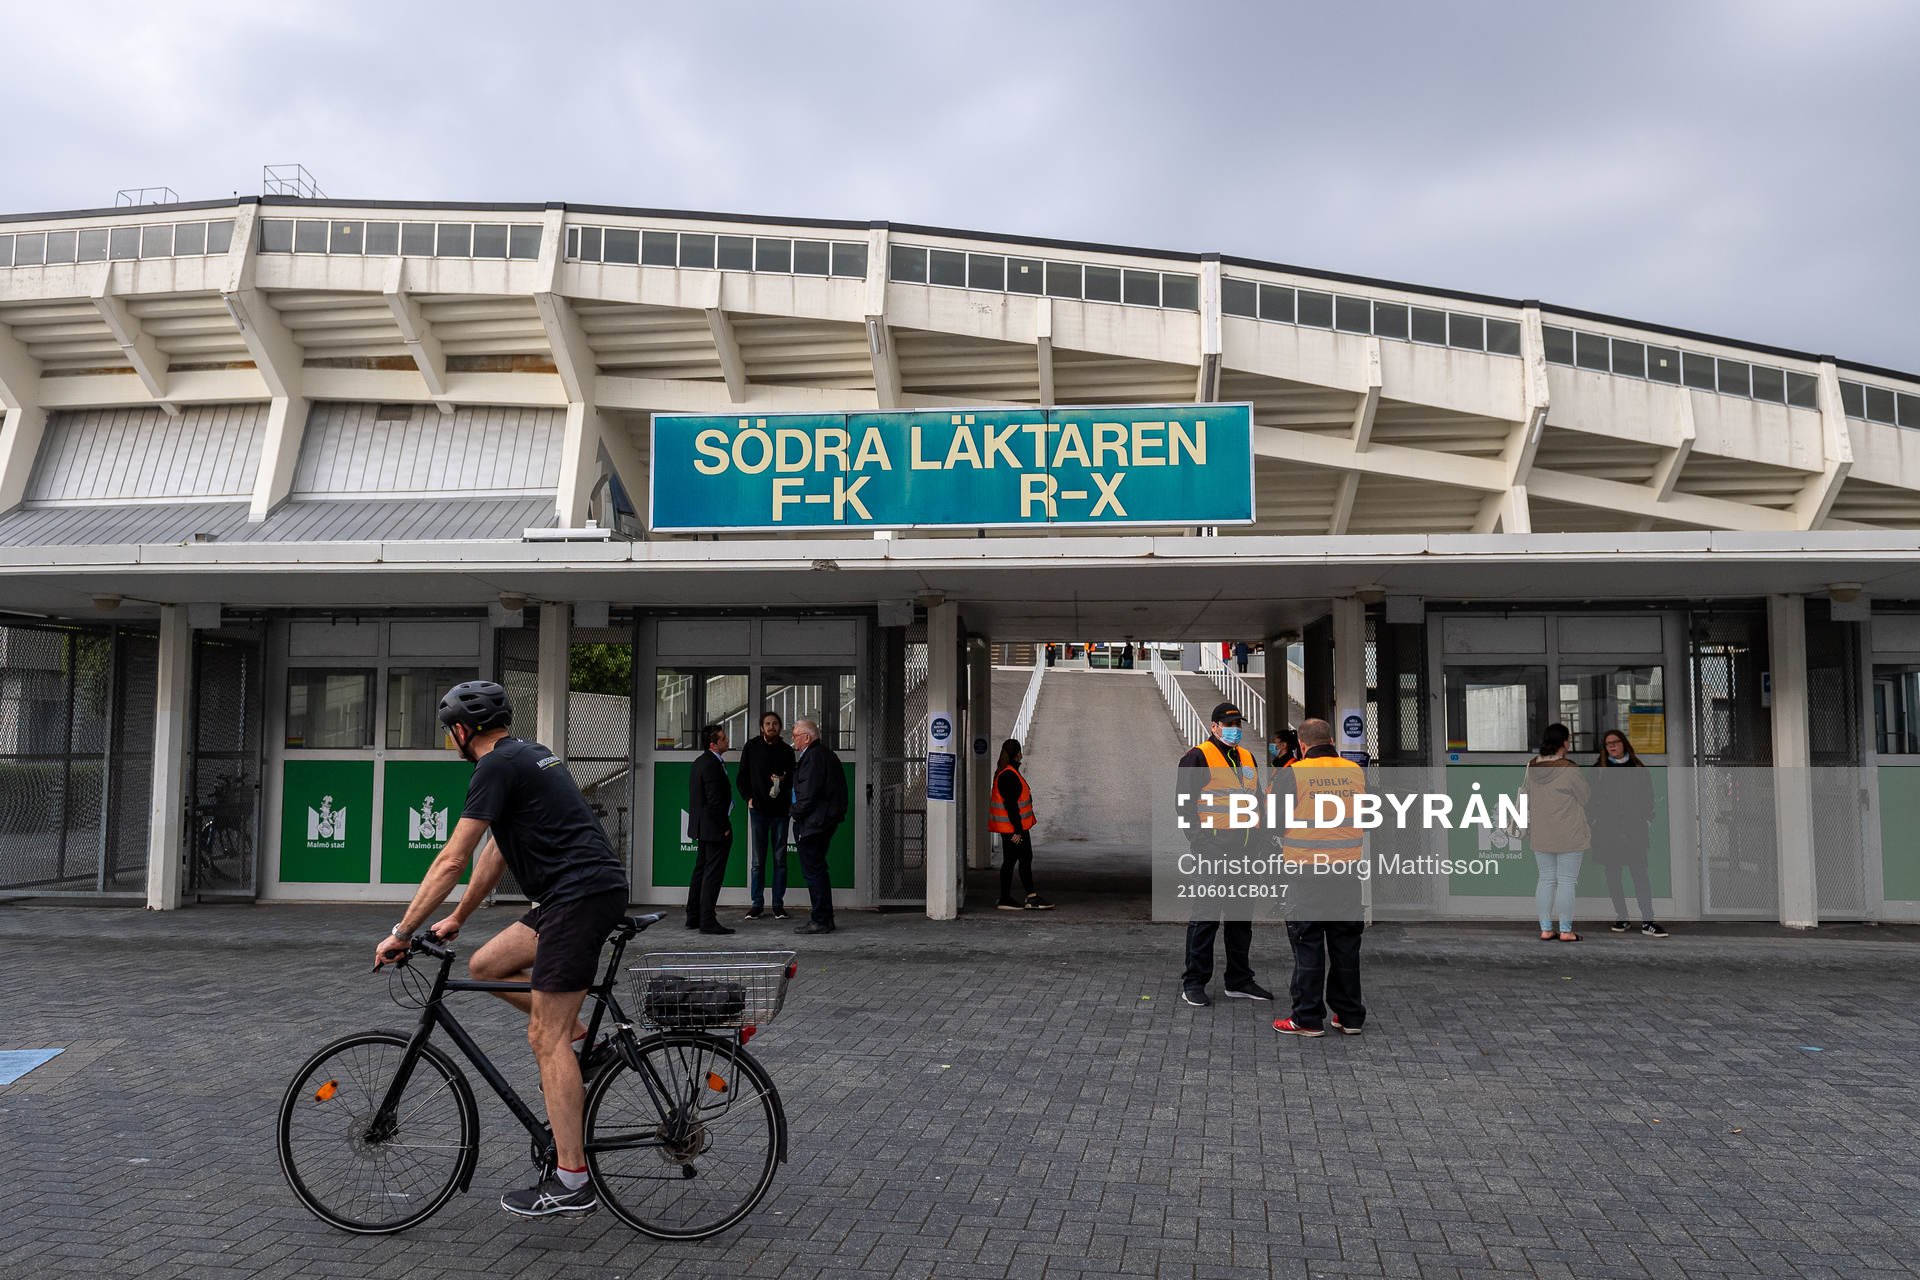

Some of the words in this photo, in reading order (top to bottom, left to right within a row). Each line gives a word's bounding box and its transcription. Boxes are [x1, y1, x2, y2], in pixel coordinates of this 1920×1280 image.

[694, 419, 892, 474] SÖDRA
[911, 415, 1206, 469] LÄKTAREN
[1309, 778, 1352, 787] PUBLIK-
[1478, 852, 1505, 860] Malmö
[1506, 852, 1522, 860] stad
